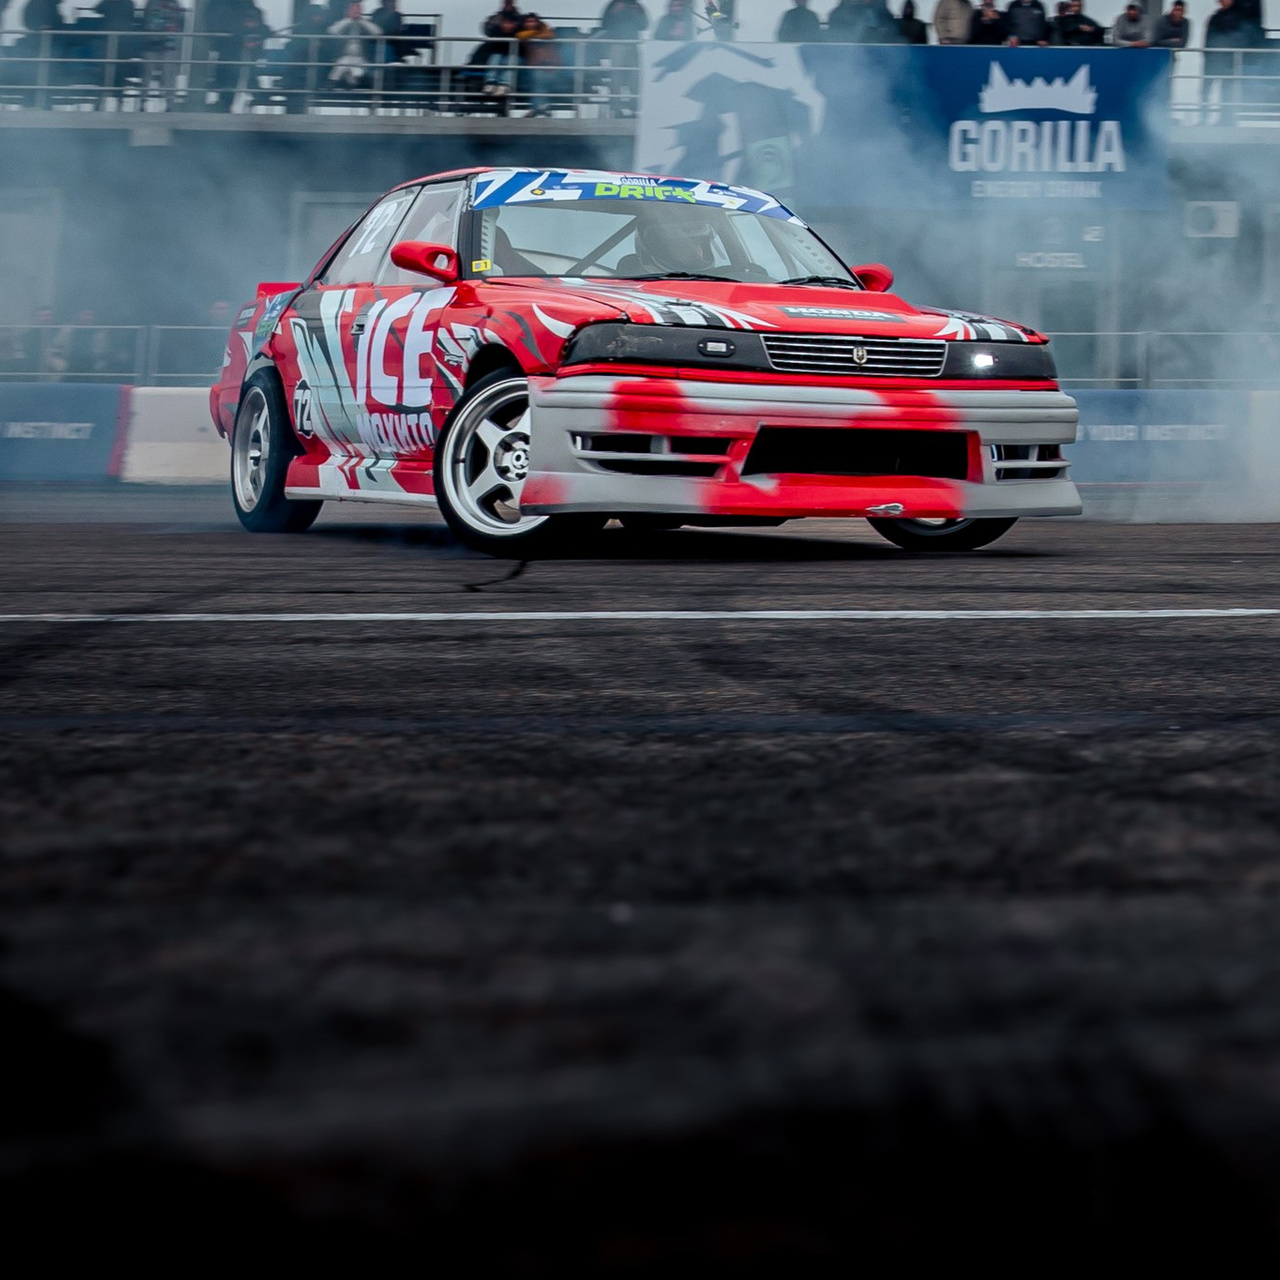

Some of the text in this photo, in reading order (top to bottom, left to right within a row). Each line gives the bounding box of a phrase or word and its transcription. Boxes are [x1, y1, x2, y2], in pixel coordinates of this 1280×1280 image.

[949, 120, 1127, 172] GORILLA
[594, 183, 696, 204] DRIFT
[621, 177, 657, 187] GORILLA
[295, 388, 313, 431] 72
